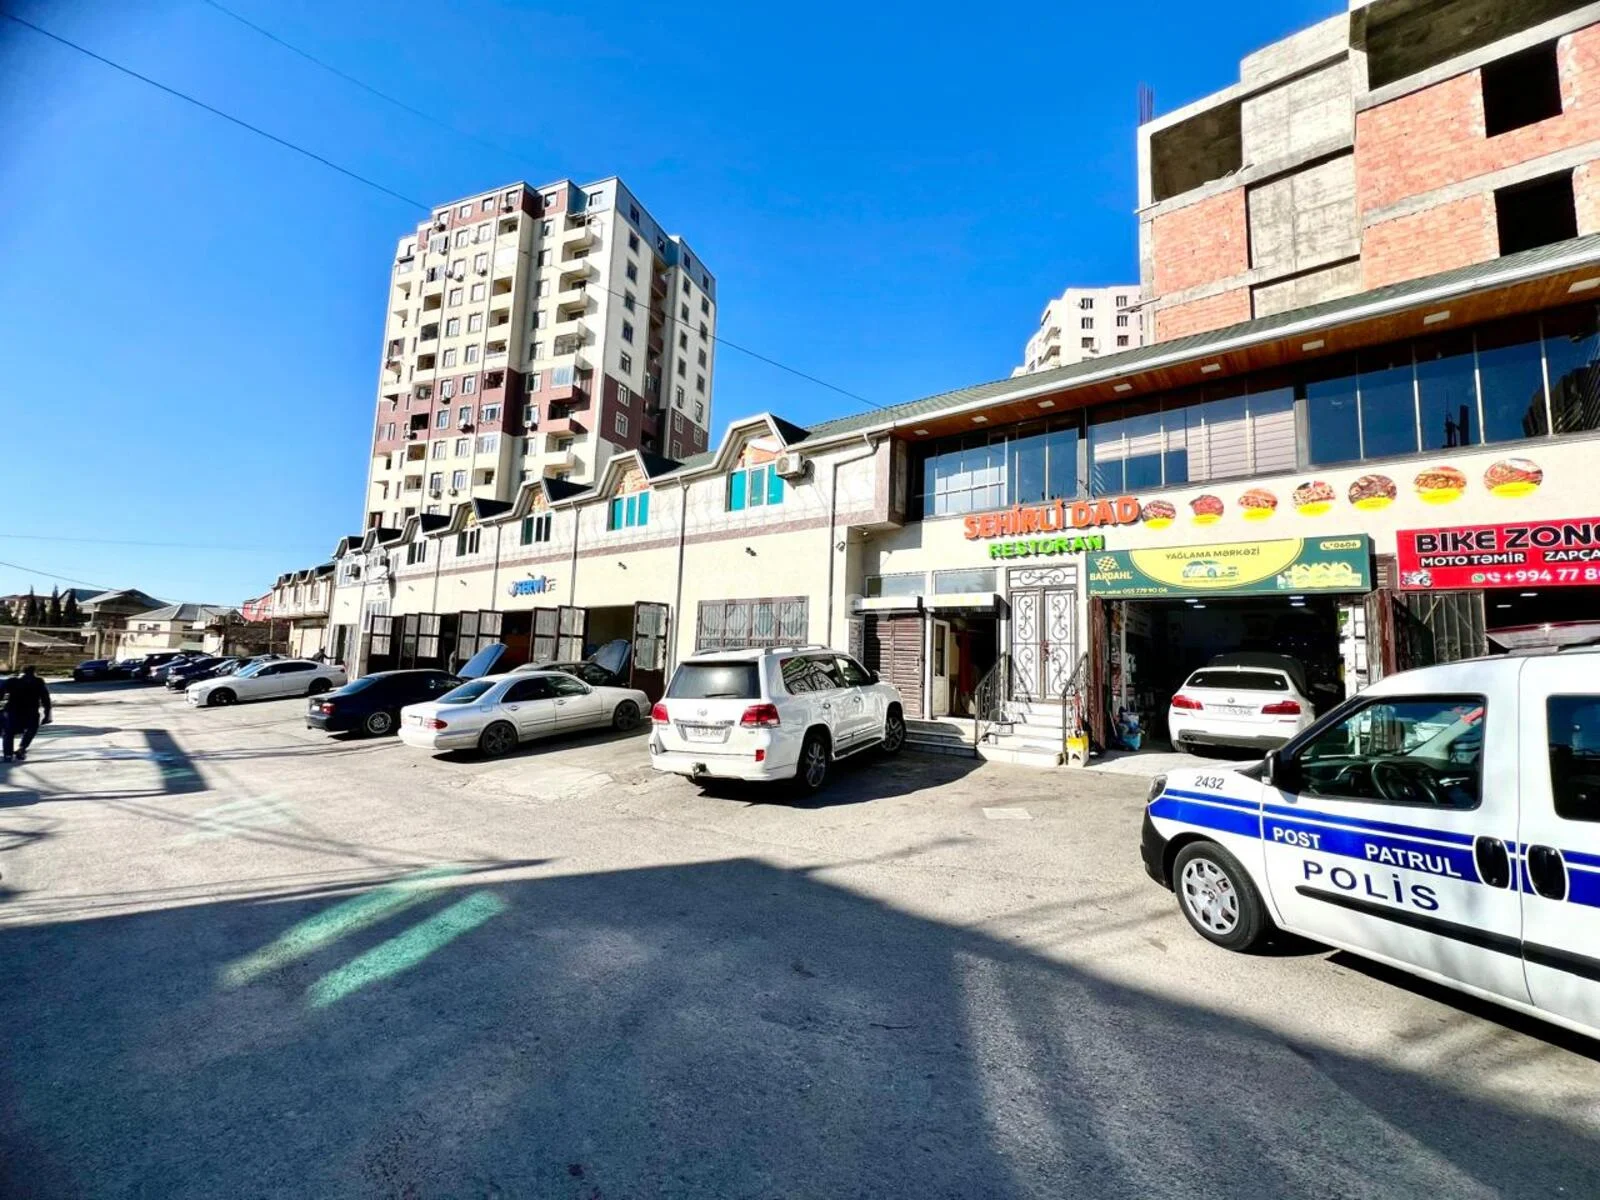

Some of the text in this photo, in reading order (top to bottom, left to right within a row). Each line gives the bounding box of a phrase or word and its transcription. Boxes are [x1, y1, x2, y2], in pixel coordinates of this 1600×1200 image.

[1071, 495, 1140, 528] DAD
[988, 535, 1105, 558] RESTORAN
[1416, 530, 1496, 553] BIKE
[1421, 555, 1468, 567] MOTO
[1469, 551, 1525, 565] TƏMİR
[1090, 571, 1132, 580] BARDAHL
[1504, 568, 1600, 582] +994 77 8
[1194, 775, 1225, 790] 2432
[1273, 827, 1462, 877] POST PATRUL
[1303, 860, 1439, 911] POLİS
